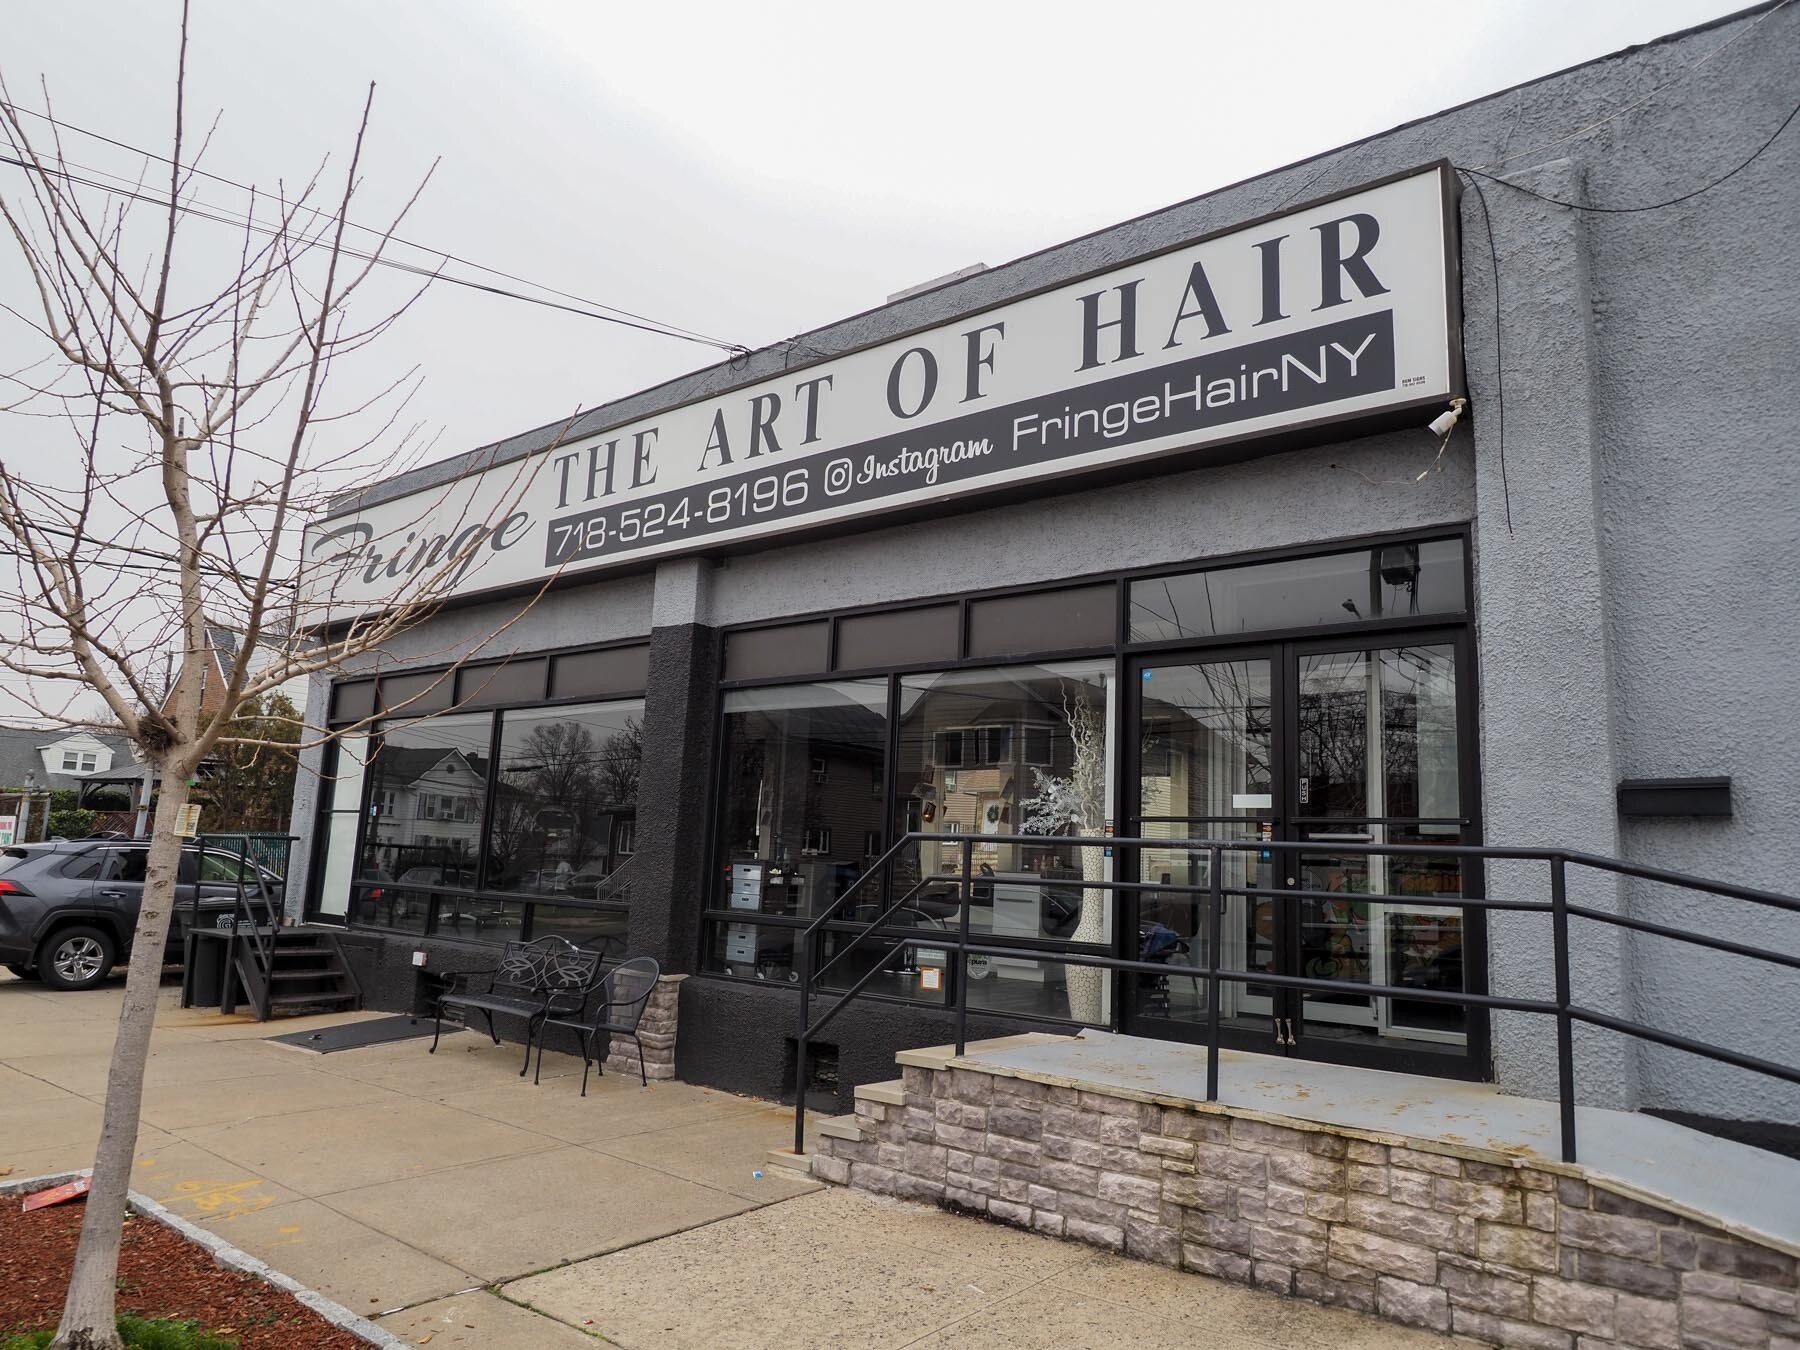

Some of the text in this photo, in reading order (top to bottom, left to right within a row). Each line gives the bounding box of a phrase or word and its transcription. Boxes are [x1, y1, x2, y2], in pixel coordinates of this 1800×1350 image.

[553, 213, 1392, 510] THE ART OF HAIR
[554, 333, 1377, 556] 718-524-8196 Instagram FringeHairNY
[311, 511, 537, 594] Fringe
